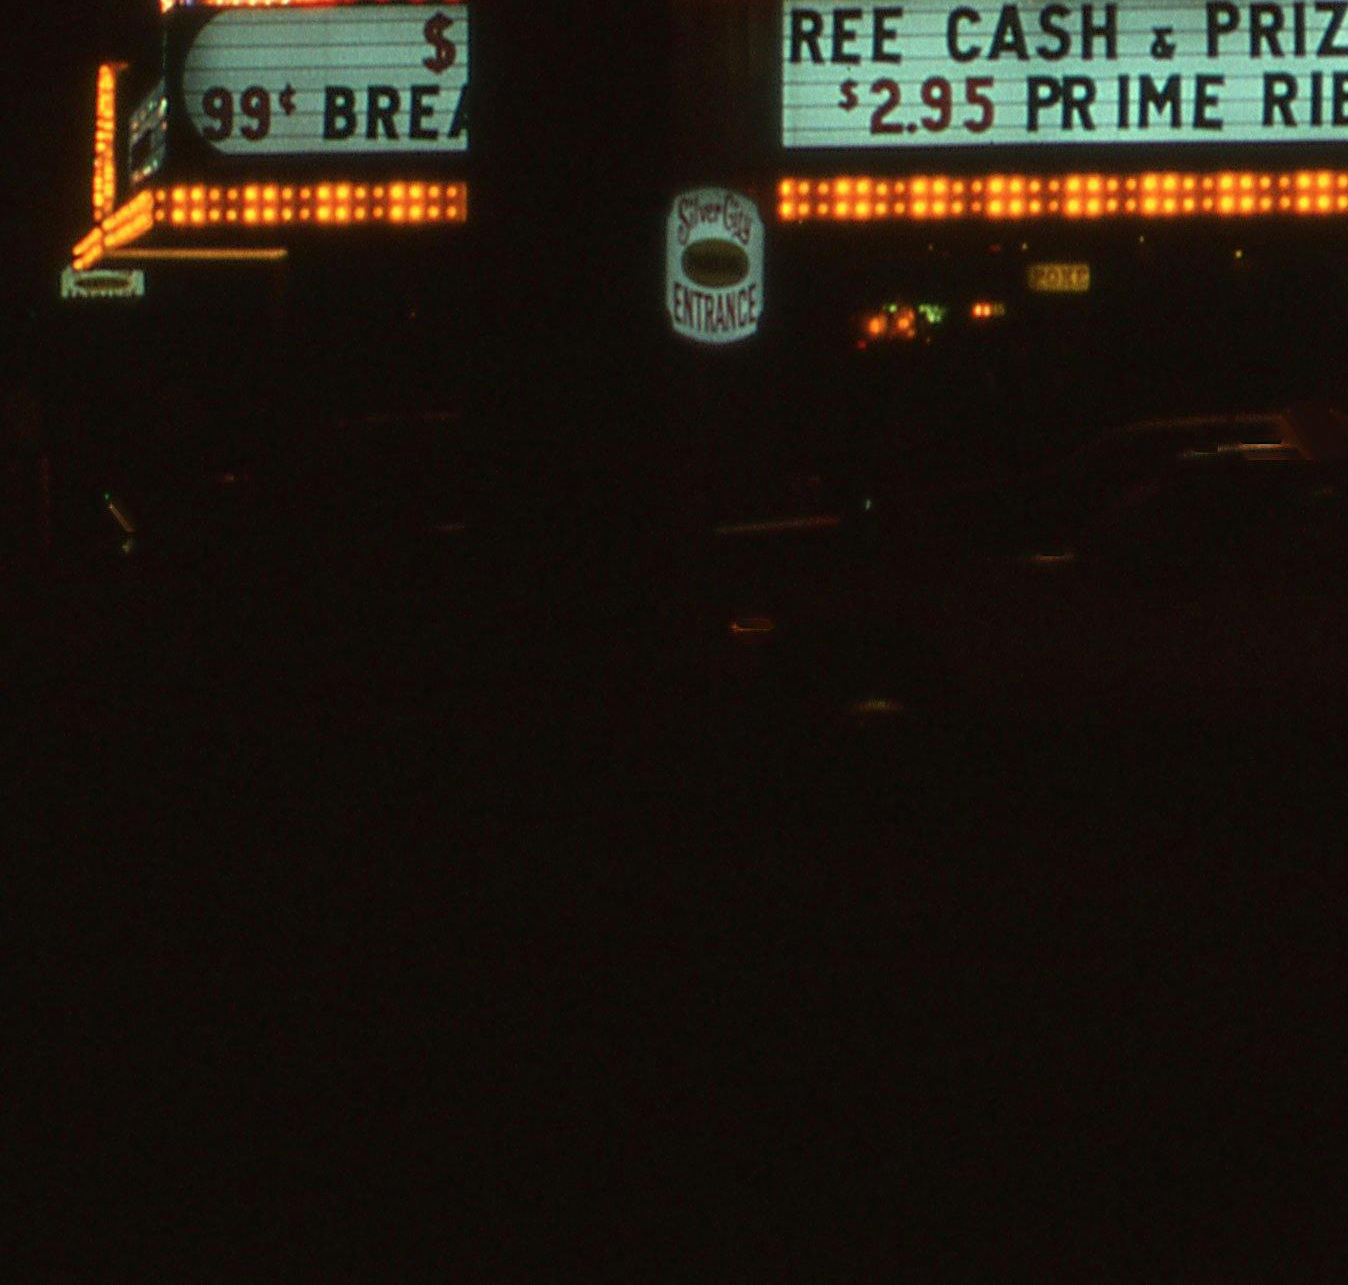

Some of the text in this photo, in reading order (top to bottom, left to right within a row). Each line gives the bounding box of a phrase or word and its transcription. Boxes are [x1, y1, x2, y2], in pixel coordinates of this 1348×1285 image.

[946, 3, 1119, 62] CASH
[1149, 27, 1176, 60] &
[201, 84, 297, 141] 99¢
[837, 75, 996, 135] $2.95
[1026, 74, 1226, 132] PRIME
[673, 281, 757, 333] ENTRANCE
